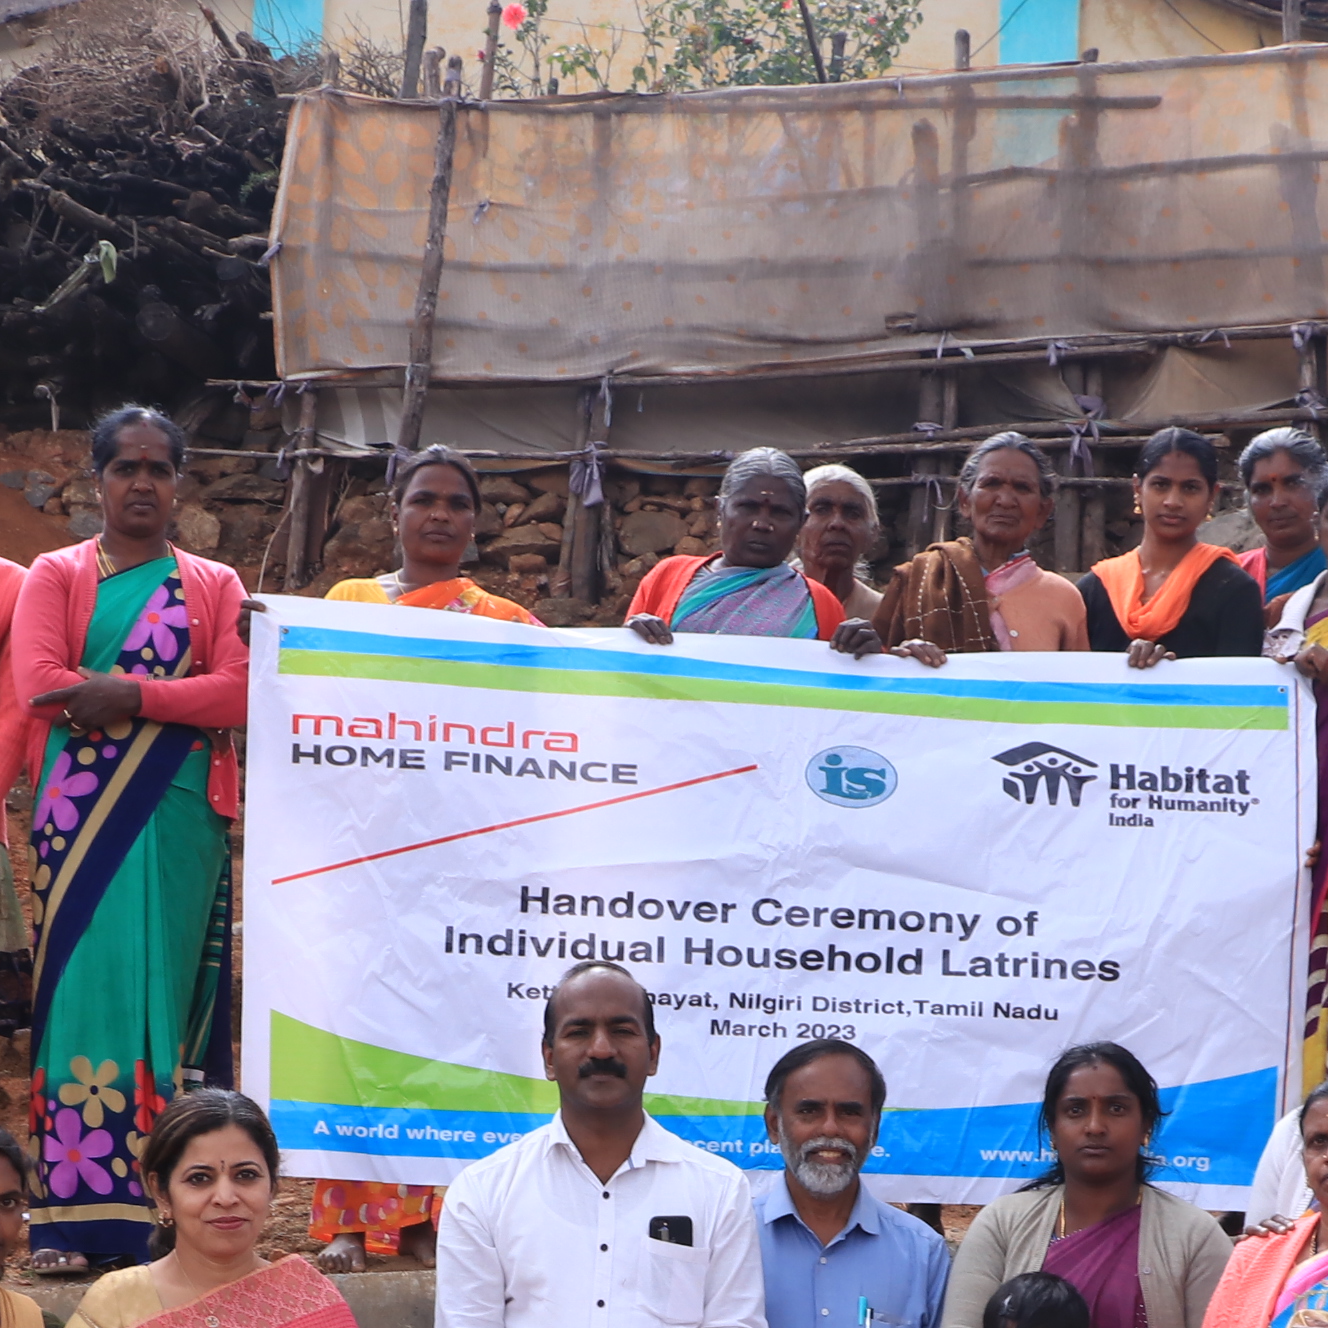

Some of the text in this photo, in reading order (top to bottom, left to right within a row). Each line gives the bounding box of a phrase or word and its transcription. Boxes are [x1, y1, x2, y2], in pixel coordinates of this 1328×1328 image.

[291, 712, 579, 753] mahindra
[291, 743, 639, 786] HOME FINANCE
[1109, 763, 1251, 795] Habitat
[1109, 793, 1142, 810] for
[1108, 813, 1155, 828] India
[519, 885, 1039, 941] Handover Ceremony of
[444, 925, 1121, 982] Individual Household Latrines
[729, 992, 802, 1014] Nilgiri
[992, 1002, 1059, 1021] Nadu
[709, 1019, 857, 1041] March 2023
[313, 1120, 331, 1135] A
[335, 1123, 399, 1140] world
[406, 1126, 477, 1143] where
